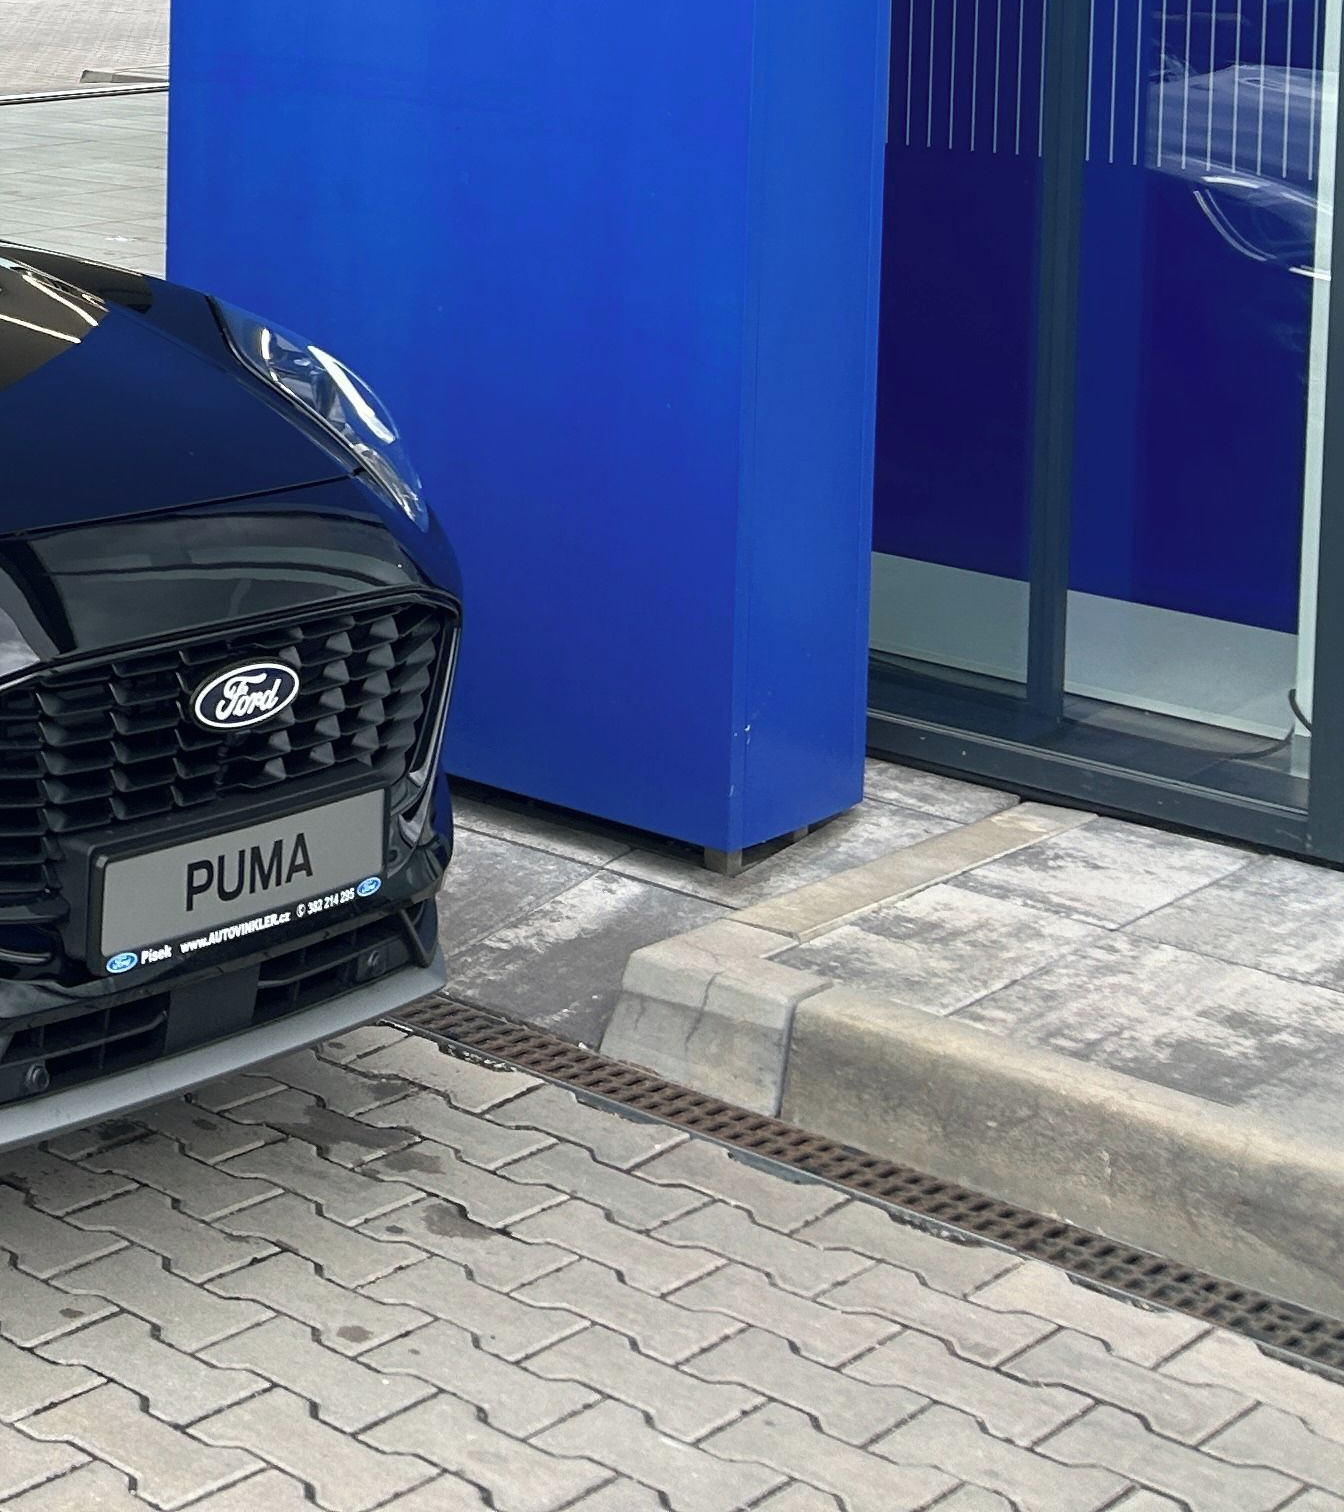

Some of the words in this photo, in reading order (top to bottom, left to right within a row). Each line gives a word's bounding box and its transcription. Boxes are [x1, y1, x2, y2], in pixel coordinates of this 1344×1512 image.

[215, 672, 282, 720] Ford
[186, 832, 313, 912] PUMA
[180, 912, 292, 954] www.AUTOVINKLER.cz
